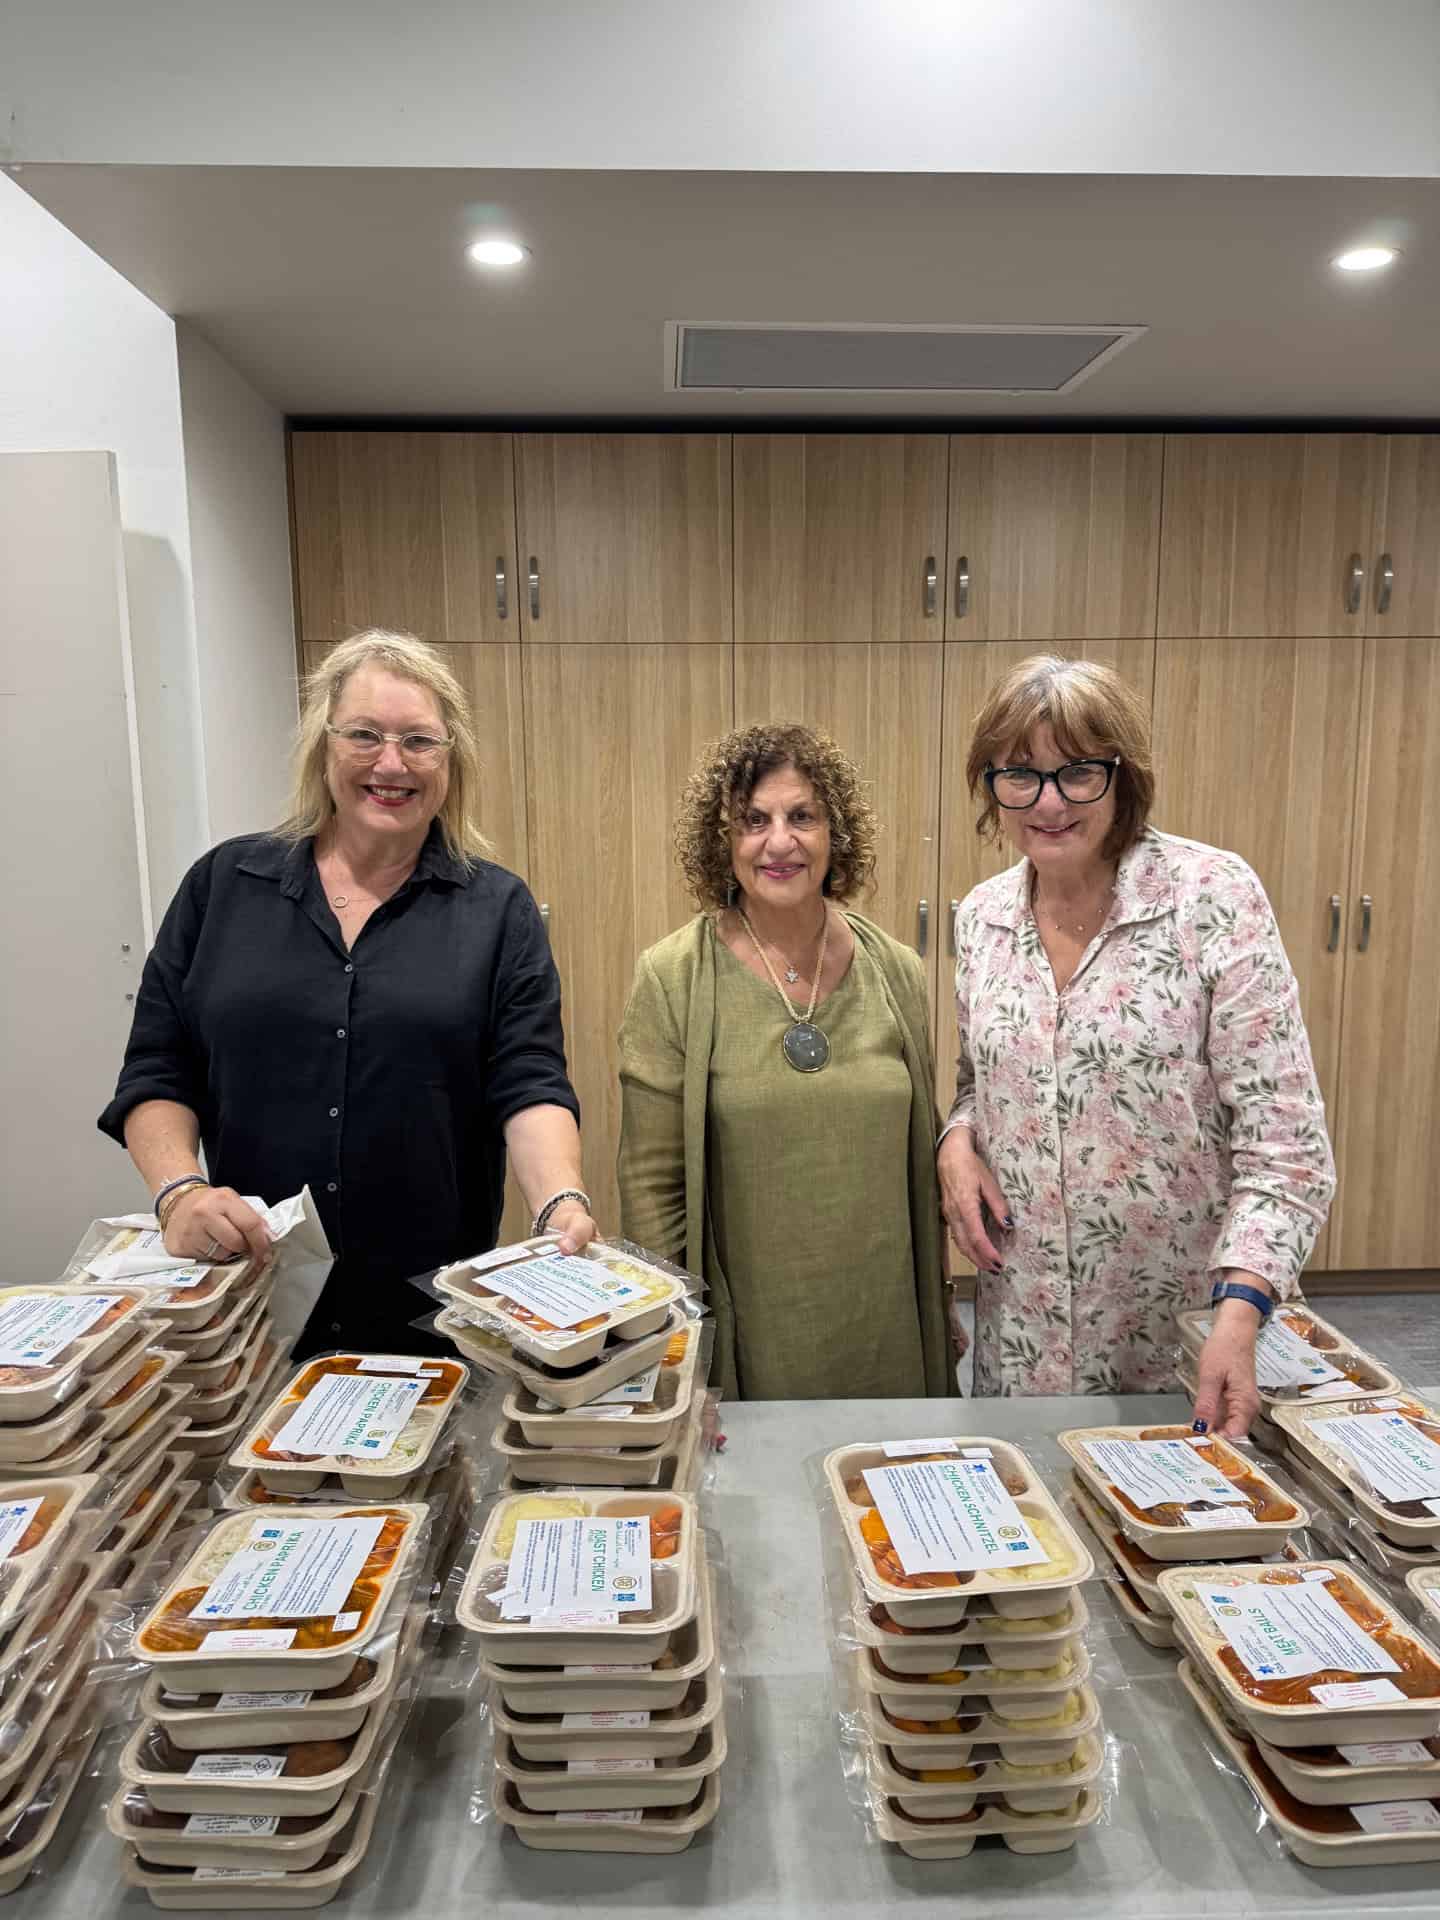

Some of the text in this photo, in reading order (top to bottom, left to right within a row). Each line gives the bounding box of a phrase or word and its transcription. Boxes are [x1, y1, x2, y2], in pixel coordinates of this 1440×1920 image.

[343, 1382, 392, 1446] CHICKEN PAPRIKA
[943, 1464, 972, 1504] CHICKEN
[964, 1503, 1001, 1554] SCHNITZEL
[243, 1565, 279, 1610] CHICKEN
[274, 1530, 304, 1569] PAPRIKA
[592, 1528, 607, 1592] ROAST CHICKEN
